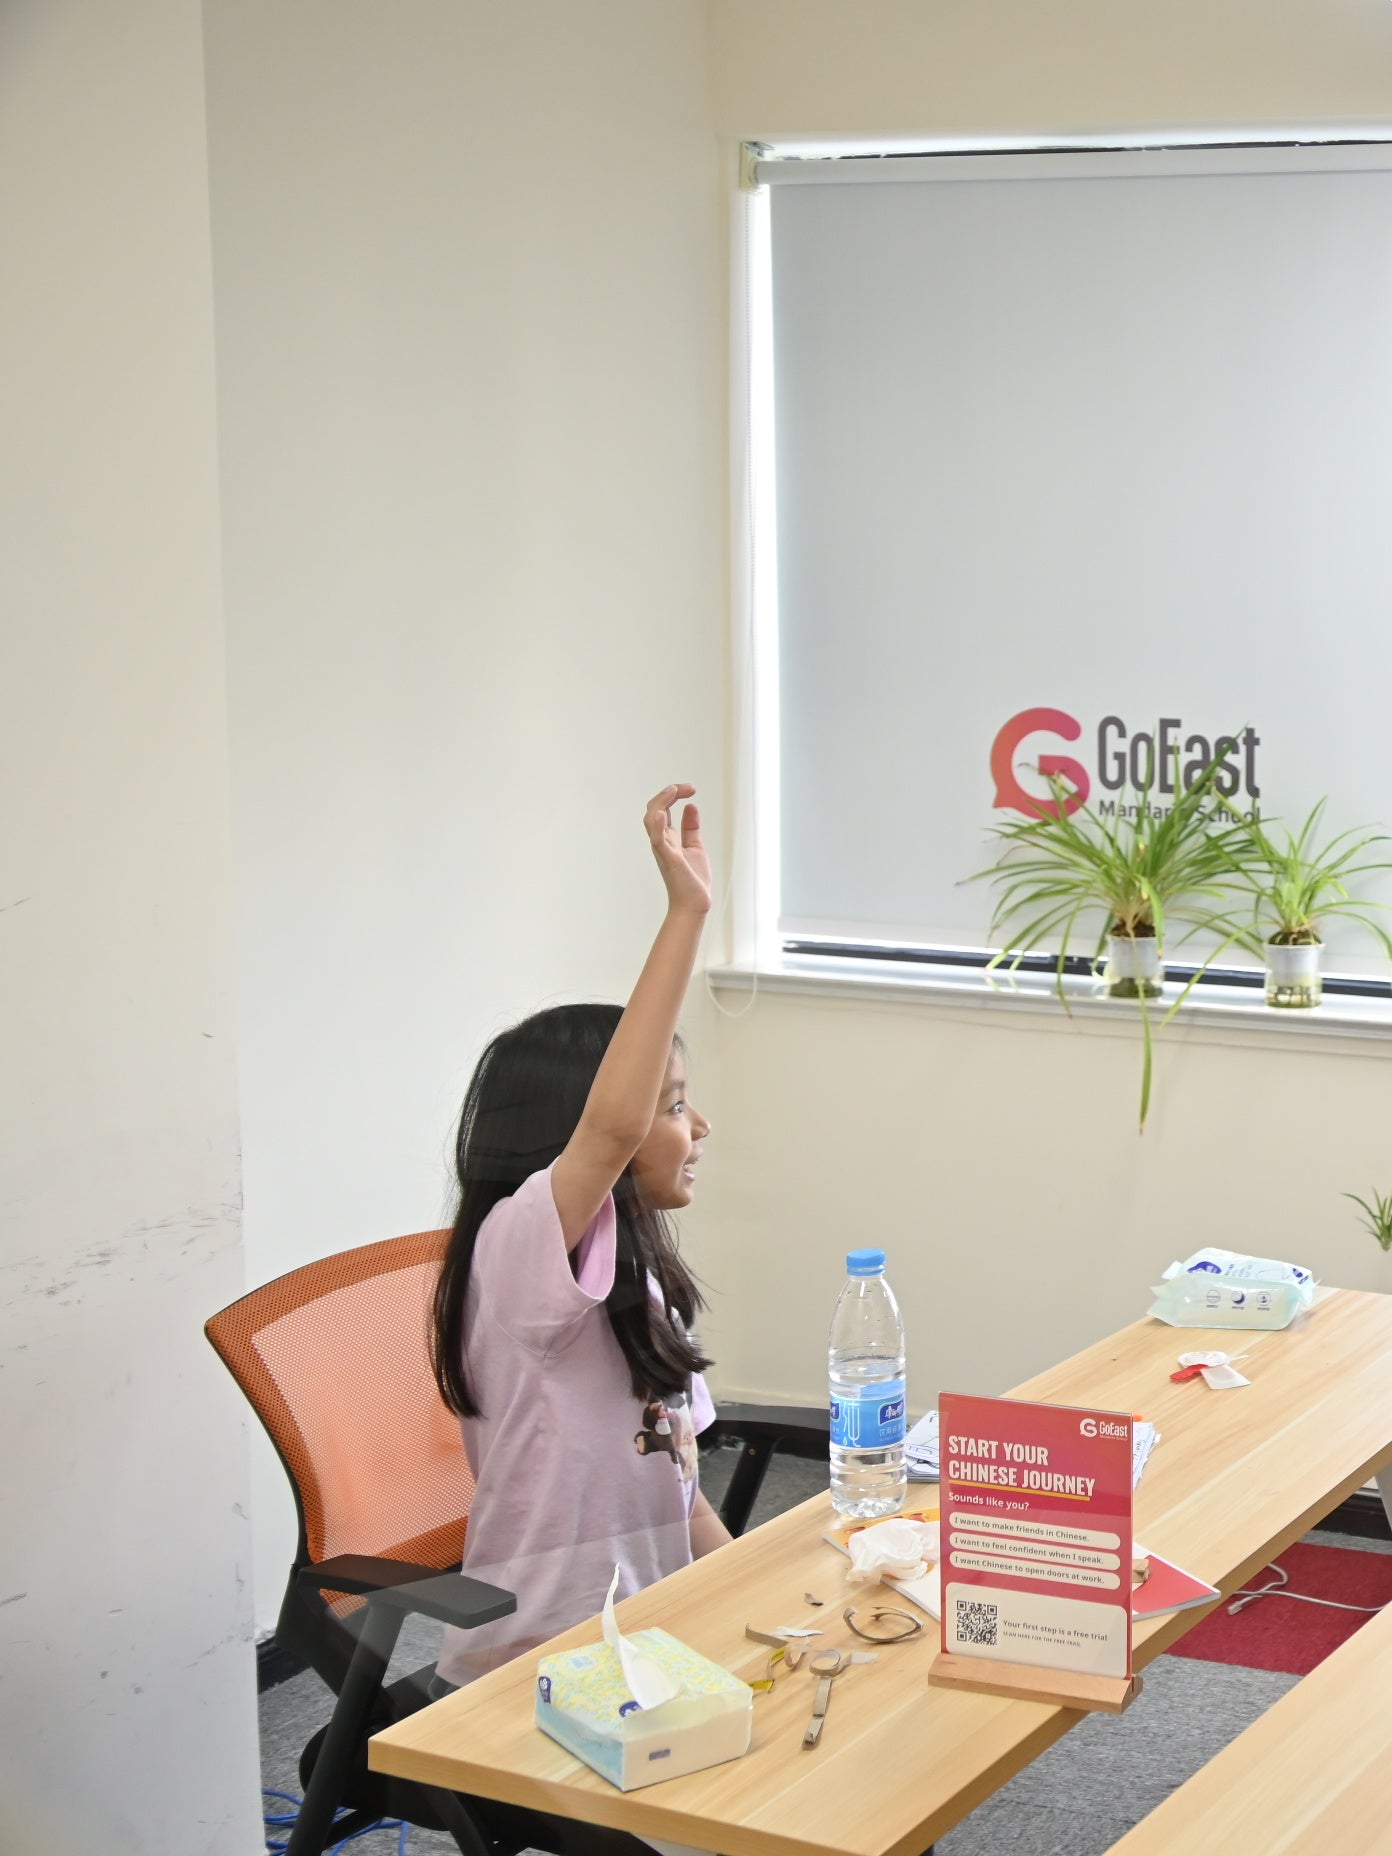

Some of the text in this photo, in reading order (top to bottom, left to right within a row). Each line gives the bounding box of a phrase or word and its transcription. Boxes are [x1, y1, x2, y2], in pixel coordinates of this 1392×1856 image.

[1097, 715, 1261, 799] GoEast
[1099, 1421, 1128, 1438] GoEast
[949, 1435, 1049, 1466] START YOUR
[949, 1460, 1096, 1497] CHINESE JOURNEY
[948, 1492, 1030, 1511] Sounds like you?
[959, 1517, 981, 1526] want
[982, 1520, 990, 1529] to
[992, 1521, 1014, 1531] make
[1016, 1524, 1044, 1536] friends
[1046, 1528, 1054, 1537] in
[1055, 1530, 1090, 1542] Chinese.
[959, 1537, 981, 1546] want
[982, 1540, 990, 1548] to
[992, 1541, 1007, 1550] feel
[1008, 1544, 1047, 1557] confident
[1049, 1549, 1071, 1560] when
[1078, 1554, 1104, 1566] speak.
[959, 1557, 981, 1566] want
[982, 1559, 1013, 1571] Chinese
[1014, 1563, 1023, 1572] to
[1025, 1566, 1045, 1577] open
[1047, 1568, 1070, 1579] doors
[1071, 1572, 1080, 1580] at
[1081, 1573, 1105, 1585] work.
[1002, 1620, 1021, 1629] Your
[1022, 1622, 1039, 1631] first
[1040, 1626, 1057, 1635] step
[1073, 1630, 1089, 1639] free
[1091, 1633, 1108, 1641] trial
